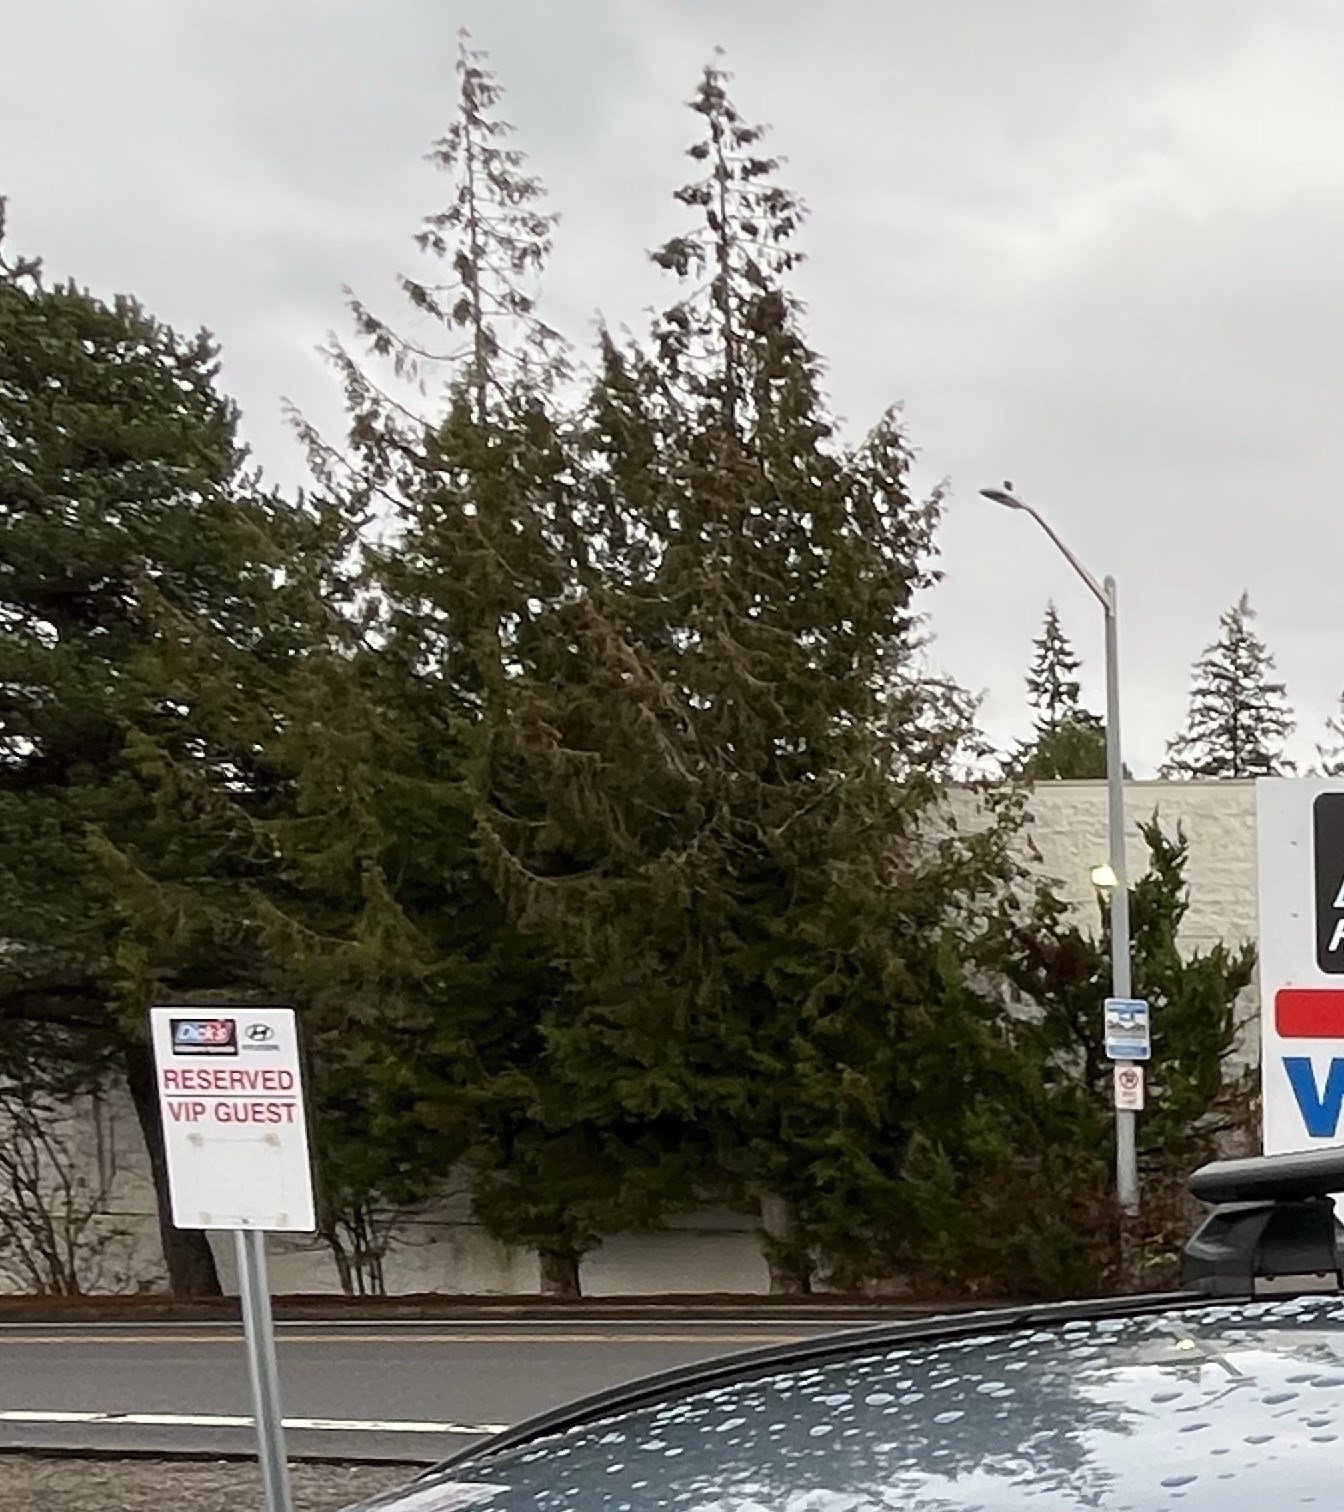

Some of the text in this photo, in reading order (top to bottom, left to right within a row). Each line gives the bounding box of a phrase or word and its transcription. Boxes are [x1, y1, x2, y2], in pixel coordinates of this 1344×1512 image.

[163, 1069, 293, 1090] RESERVED
[168, 1102, 295, 1123] VIP GUEST
